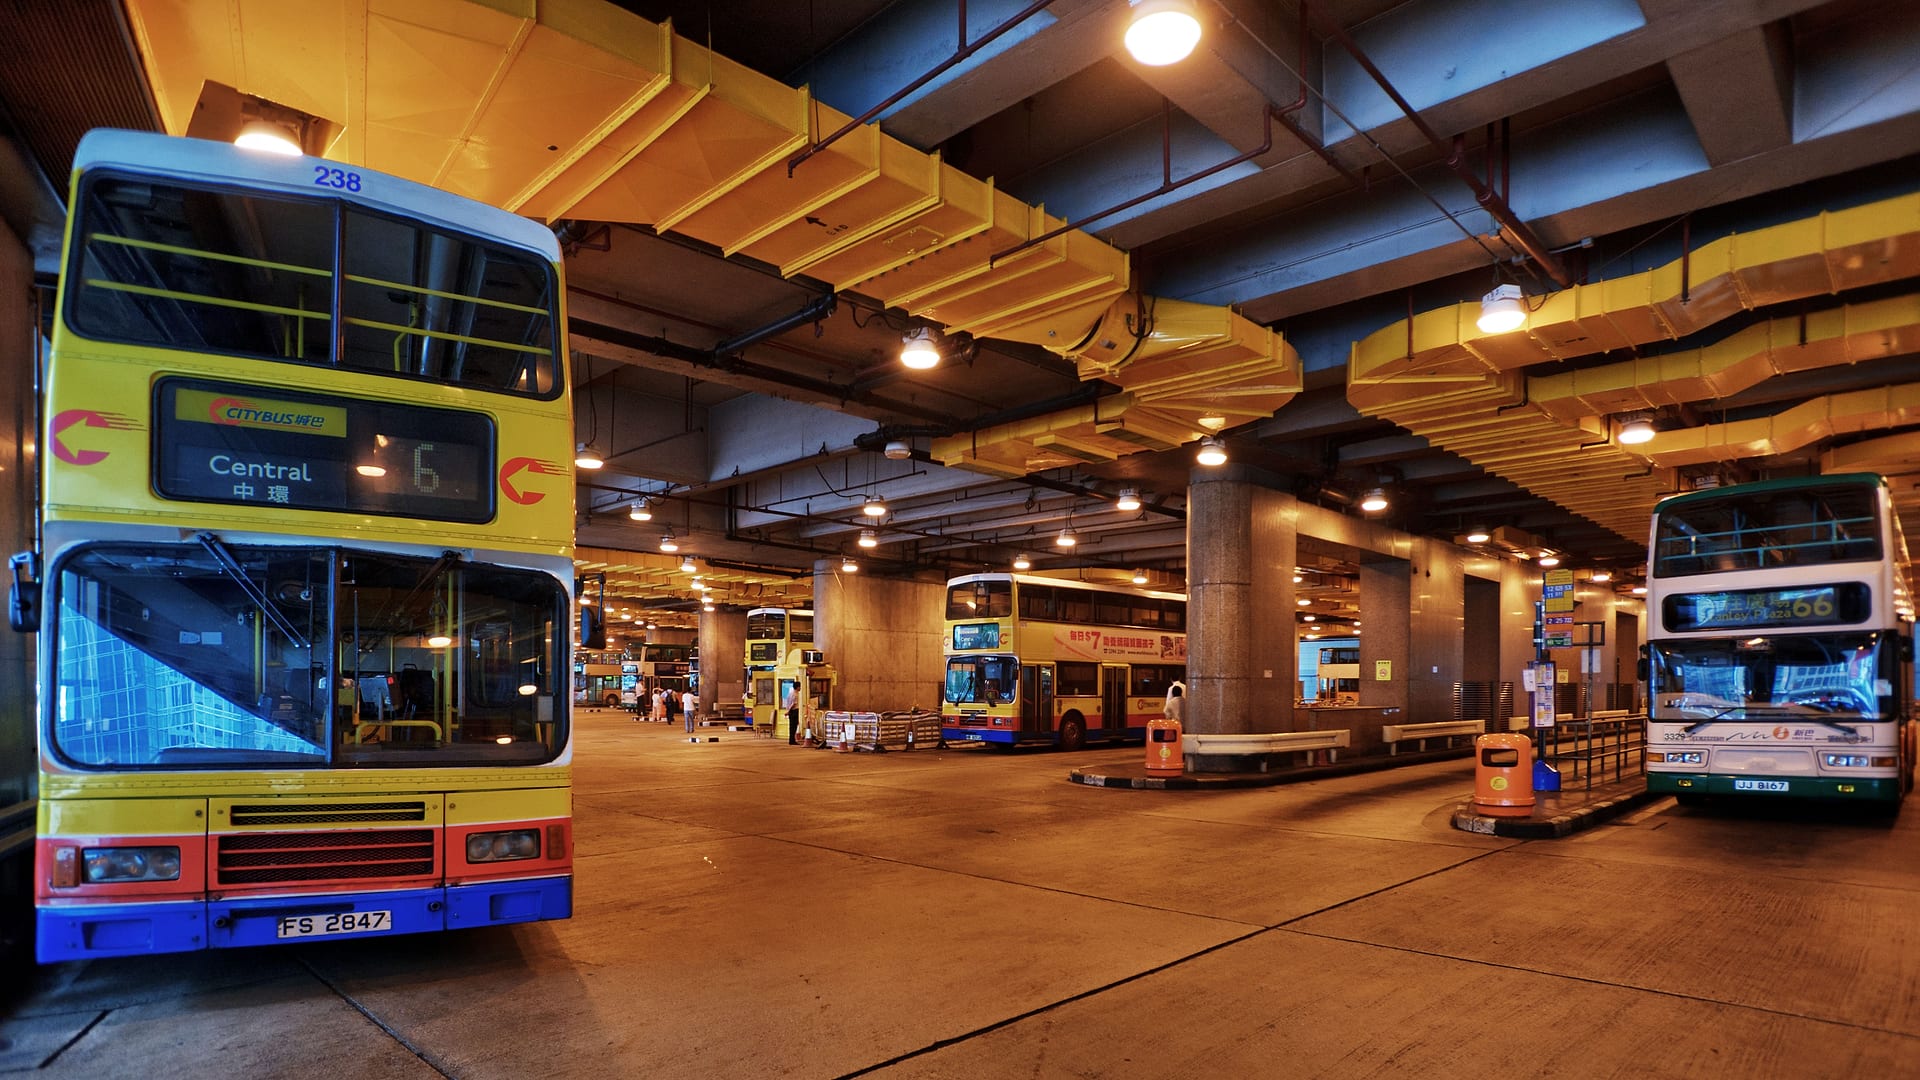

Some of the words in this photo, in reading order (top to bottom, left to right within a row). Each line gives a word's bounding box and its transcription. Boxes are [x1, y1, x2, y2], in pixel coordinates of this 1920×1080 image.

[314, 165, 361, 192] 238
[226, 407, 293, 426] CITYBUS
[294, 414, 325, 428] 城巴
[209, 455, 312, 482] Central
[413, 443, 440, 493] 6
[233, 482, 289, 503] 中環
[1754, 609, 1791, 619] Plaza
[1793, 596, 1833, 617] 66
[1758, 782, 1785, 790] 8167
[283, 917, 313, 935] FS
[325, 912, 386, 932] 2847
